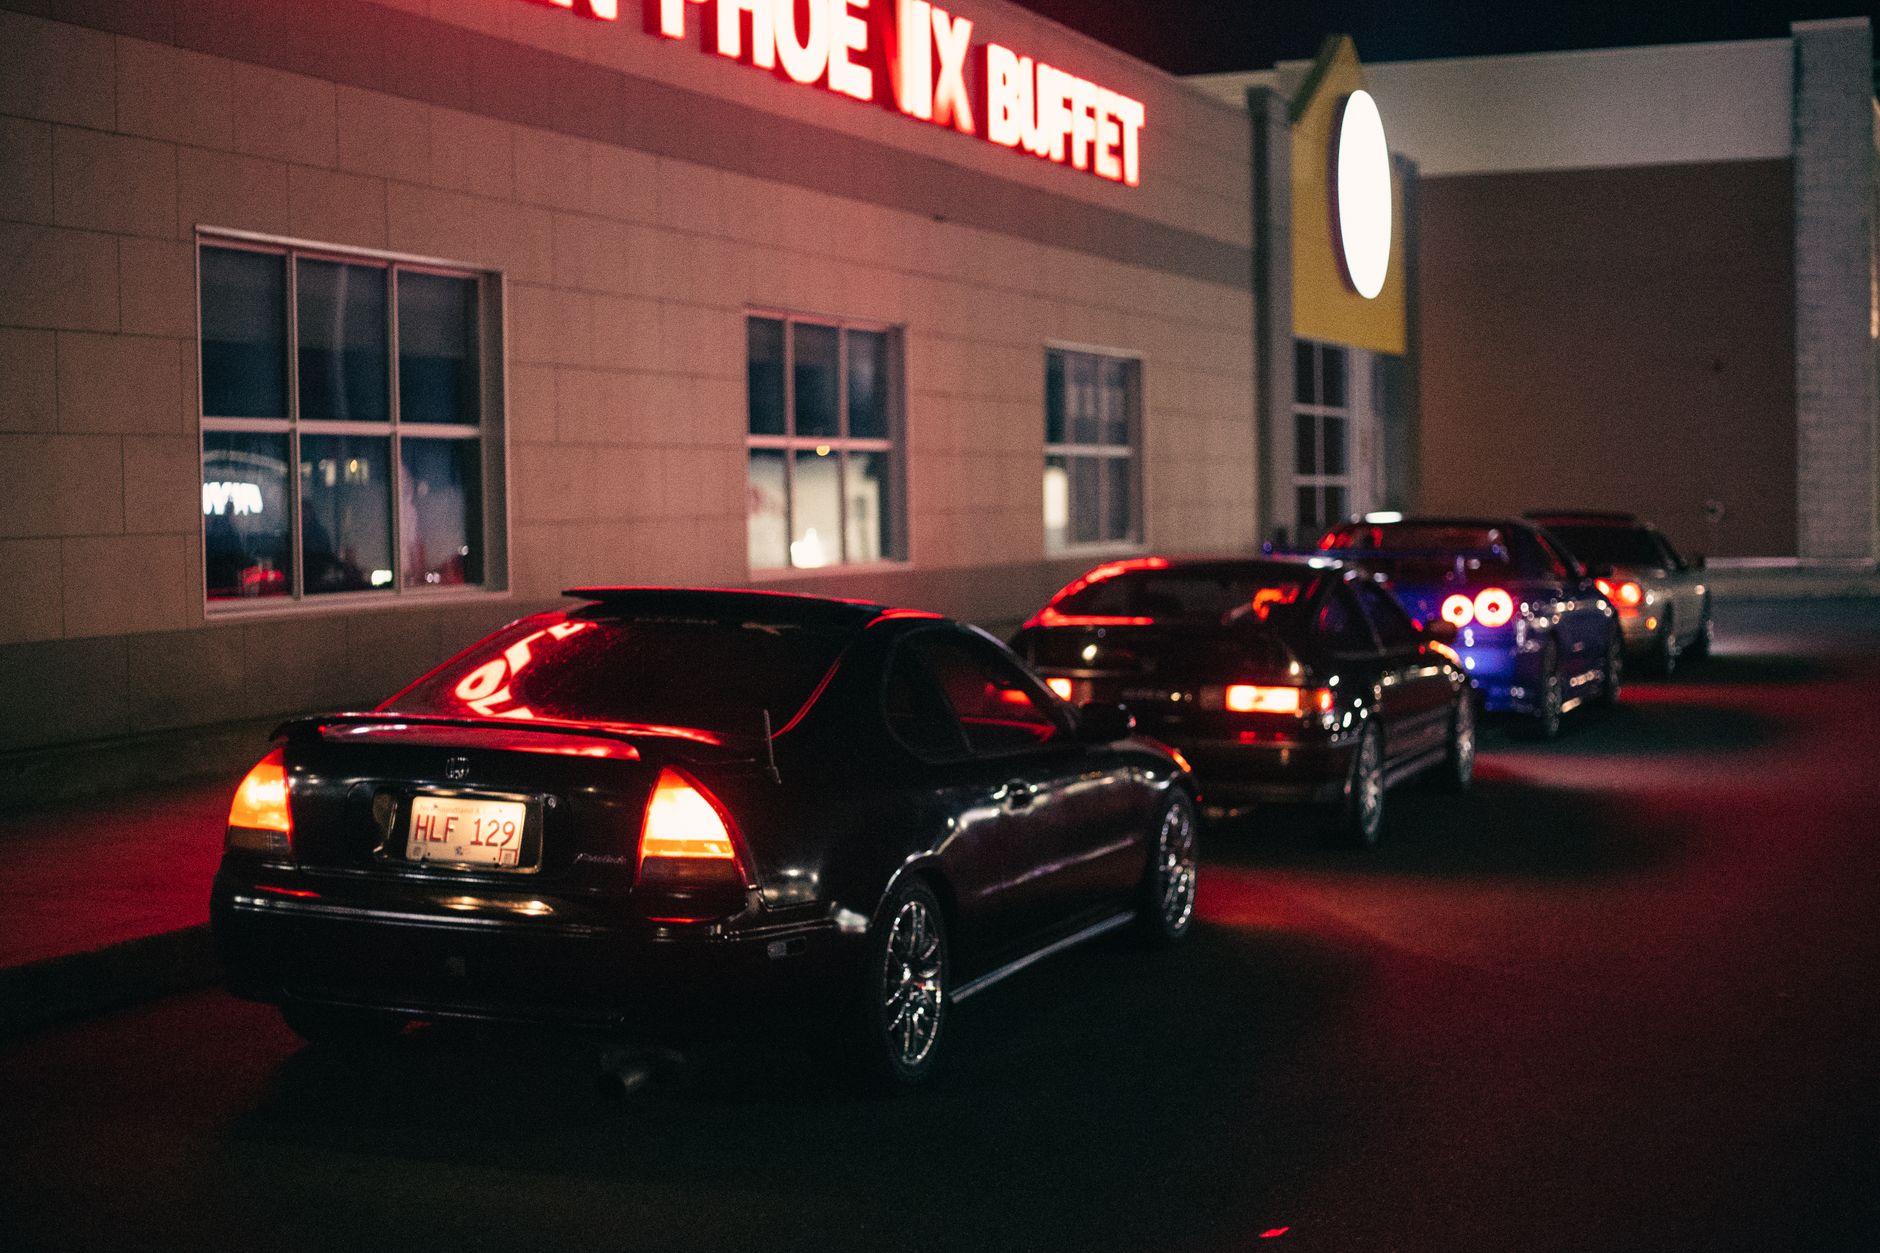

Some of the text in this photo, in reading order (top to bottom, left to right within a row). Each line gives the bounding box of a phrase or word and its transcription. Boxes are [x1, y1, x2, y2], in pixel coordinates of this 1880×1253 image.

[987, 43, 1146, 187] BUFFET
[414, 814, 516, 847] HLF 129
